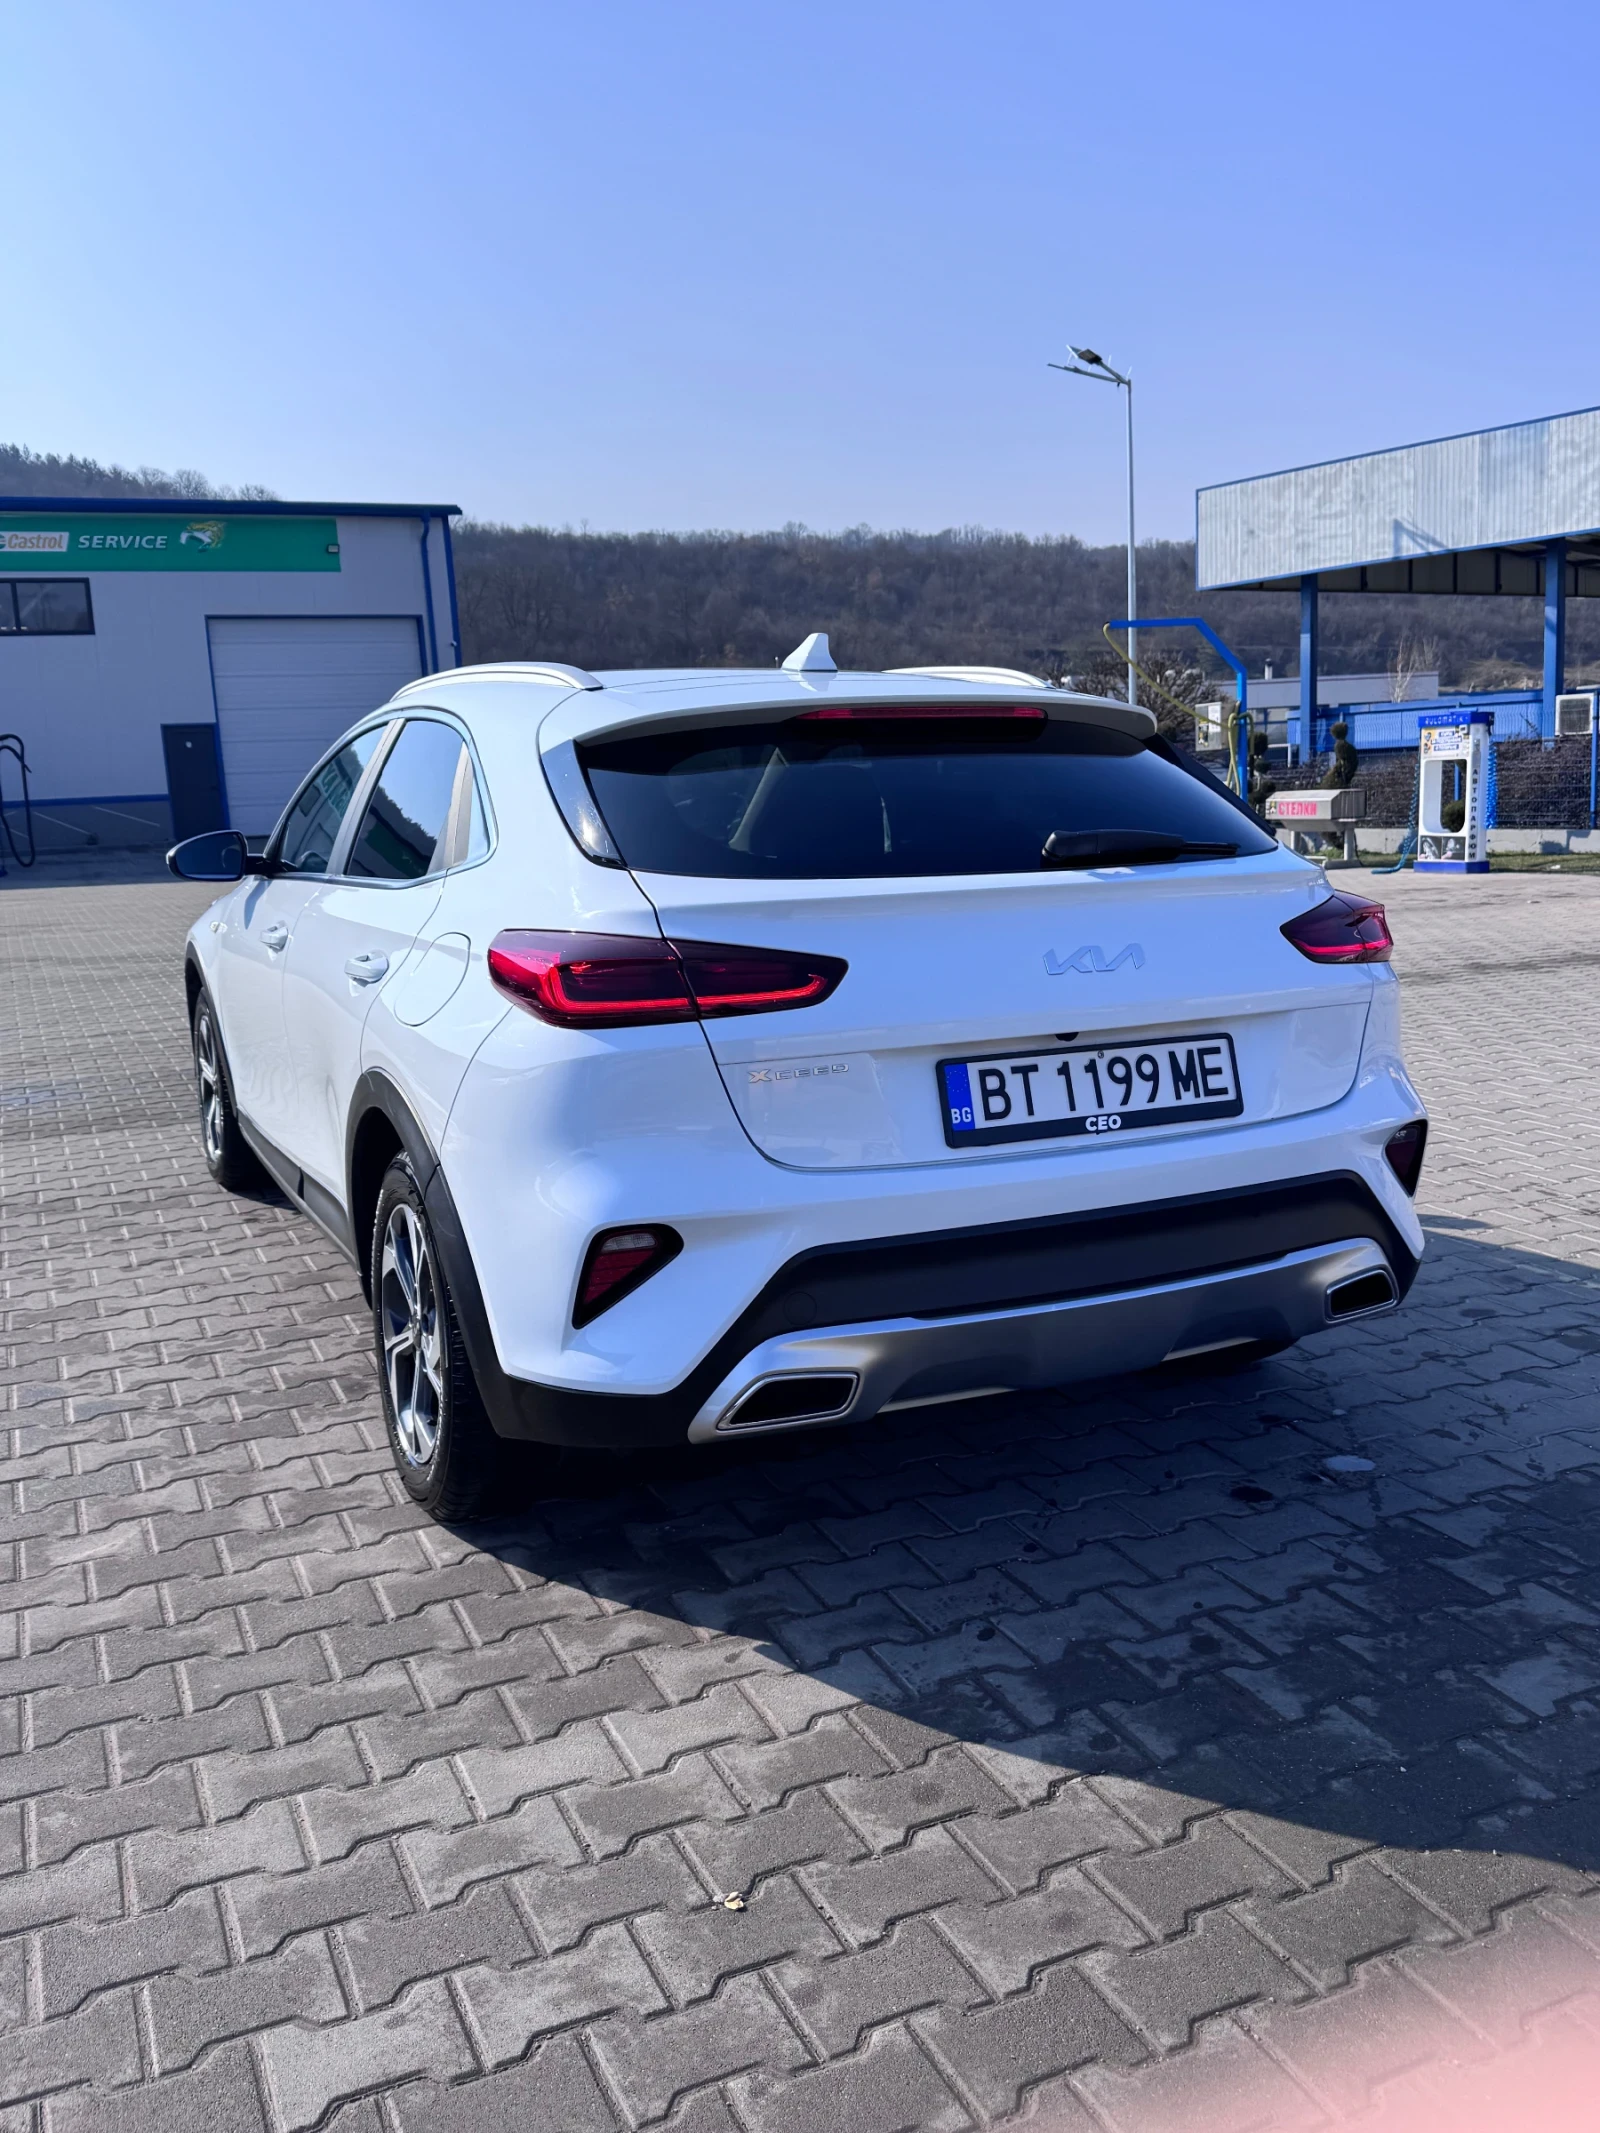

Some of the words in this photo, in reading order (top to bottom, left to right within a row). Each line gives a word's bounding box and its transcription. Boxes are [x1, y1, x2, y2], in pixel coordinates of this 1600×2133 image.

[7, 533, 63, 549] Castrol
[78, 535, 167, 549] SERVICE
[1278, 802, 1317, 816] СТЕЛКИ
[1468, 768, 1478, 859] АВТОПАРФЮМ
[748, 1063, 849, 1083] XCEED
[978, 1064, 1039, 1121] BT
[1057, 1053, 1160, 1112] 1199
[1168, 1046, 1229, 1101] ME
[951, 1108, 972, 1124] BG
[1085, 1115, 1122, 1132] CEO
